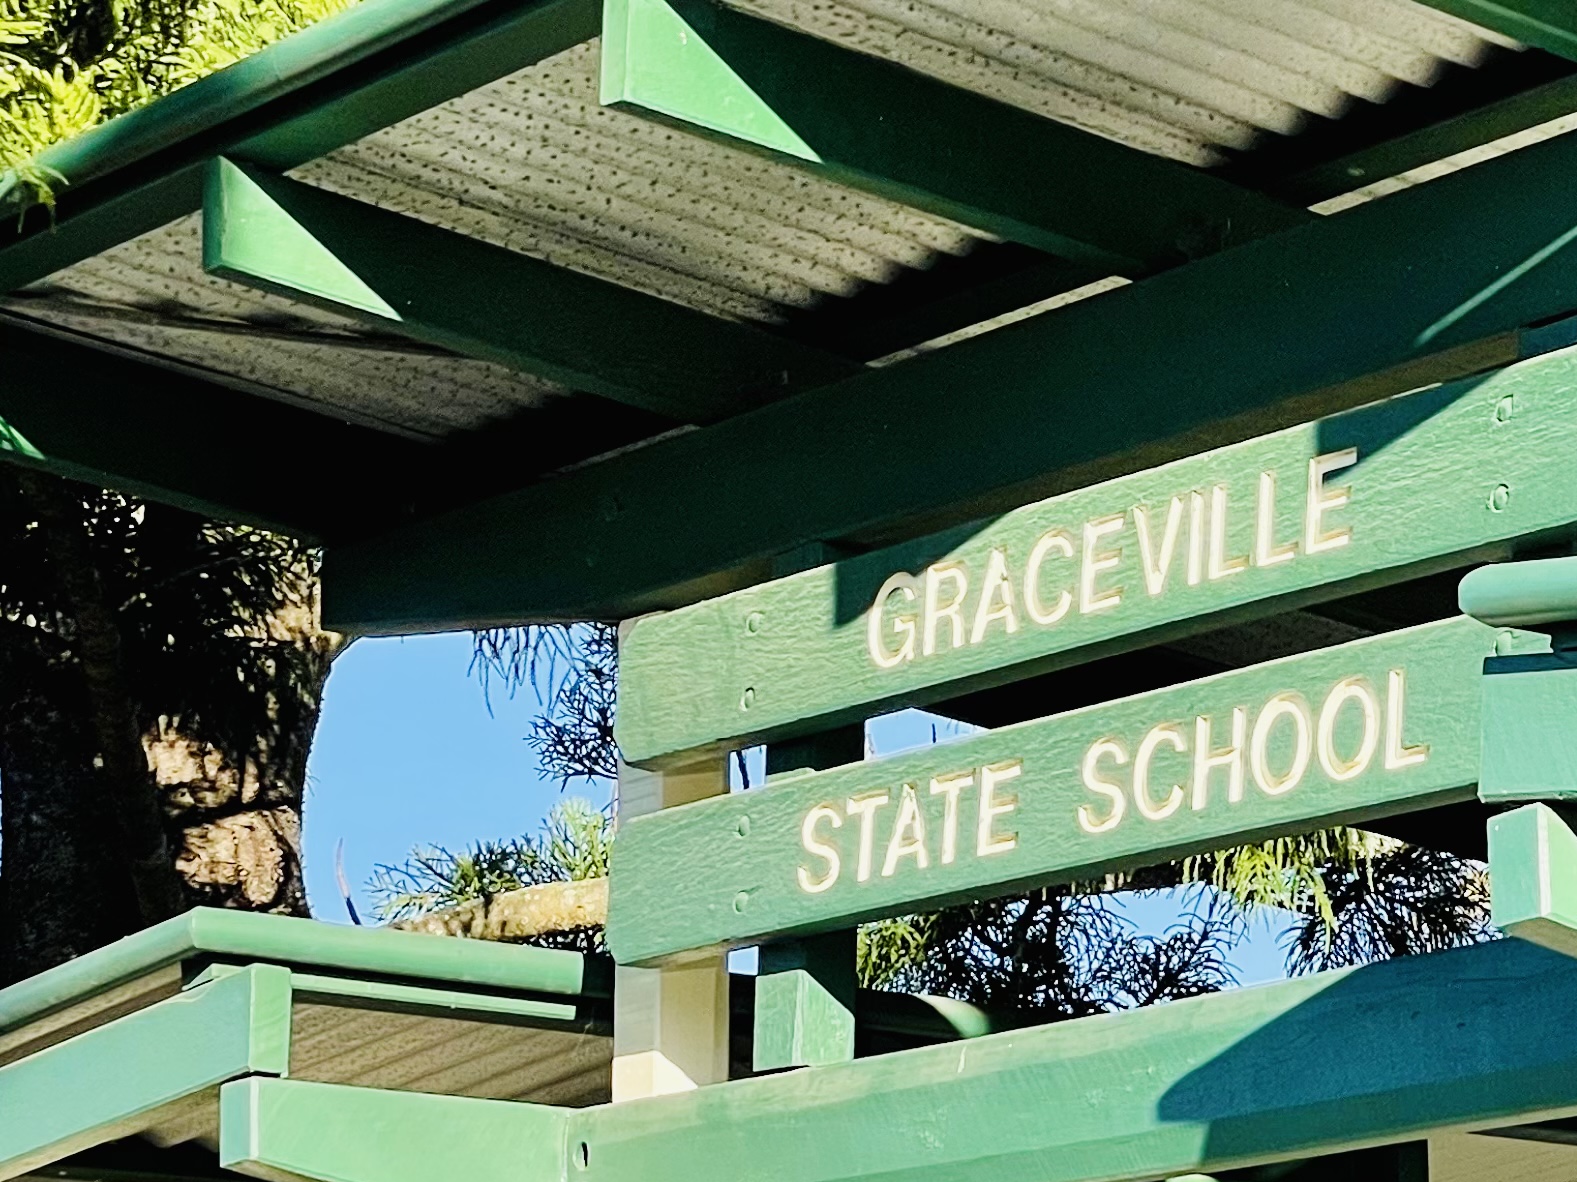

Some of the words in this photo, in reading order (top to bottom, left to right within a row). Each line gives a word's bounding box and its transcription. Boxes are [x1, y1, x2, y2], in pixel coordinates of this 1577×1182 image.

[868, 447, 1358, 669] GRACEVILLE
[797, 757, 1023, 894] STATE
[1077, 668, 1431, 835] SCHOOL
